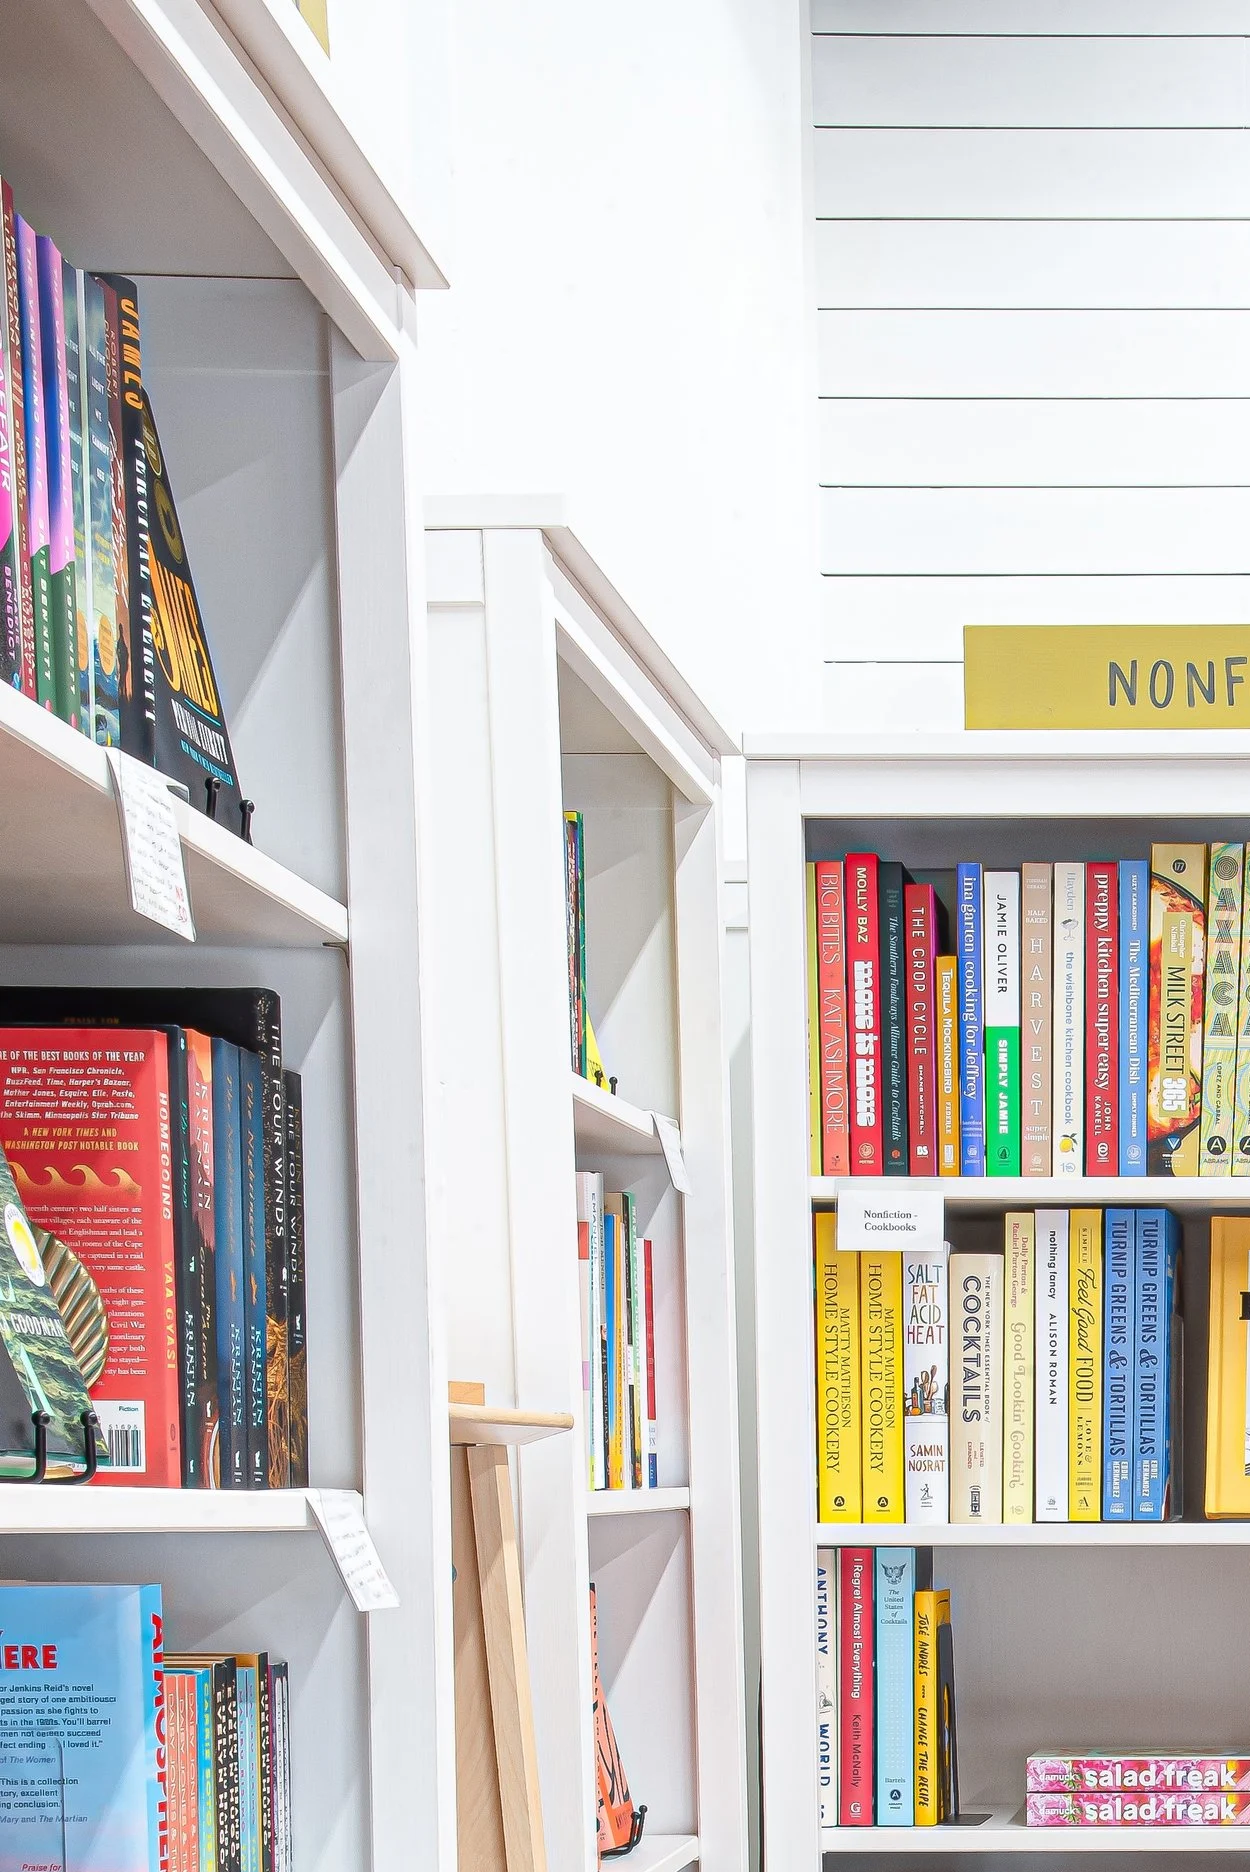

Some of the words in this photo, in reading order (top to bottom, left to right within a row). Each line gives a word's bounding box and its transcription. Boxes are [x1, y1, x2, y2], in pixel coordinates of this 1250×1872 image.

[857, 867, 867, 912] MOLLY
[1092, 873, 1110, 932] preppy
[857, 917, 868, 943] BAZ
[997, 894, 1007, 937] JAMIE
[997, 943, 1008, 994] OLIVER
[1096, 937, 1112, 999] kitchen
[1166, 966, 1186, 1009] MILK
[854, 960, 874, 1030] more
[855, 1033, 878, 1055] is
[1093, 1003, 1109, 1052] super
[1165, 1013, 1185, 1075] STREET
[10, 1052, 21, 1061] OF
[23, 1052, 38, 1061] THE
[41, 1052, 60, 1061] BEST
[63, 1052, 90, 1061] BOOKS
[93, 1052, 102, 1061] OF
[106, 1052, 121, 1062] THE
[124, 1052, 145, 1062] YEAR
[998, 1040, 1008, 1088] SIMPLY
[1093, 1053, 1110, 1090] easy
[855, 1058, 876, 1127] more
[999, 1092, 1008, 1135] JAMIE
[1162, 1077, 1187, 1111] 365
[1094, 1096, 1102, 1136] KANELL
[1104, 1101, 1112, 1131] JOHN
[159, 1091, 171, 1220] HOMEGOING
[864, 1210, 912, 1220] Nonfiction
[864, 1222, 917, 1232] Cookbooks
[164, 1261, 174, 1299] YAA
[868, 1264, 882, 1320] HOME
[908, 1264, 942, 1284] SALT
[912, 1284, 938, 1304] FAT
[907, 1325, 945, 1345] HEAT
[910, 1304, 941, 1324] ACID
[165, 1308, 176, 1370] GYASI
[869, 1325, 883, 1381] STYLE
[962, 1275, 981, 1423] COCKTAILS
[870, 1387, 884, 1473] COOKERY
[911, 1444, 943, 1458] SAMIN
[908, 1459, 946, 1472] NOSRAT
[1084, 1764, 1161, 1786] salad
[1165, 1764, 1236, 1786] freak
